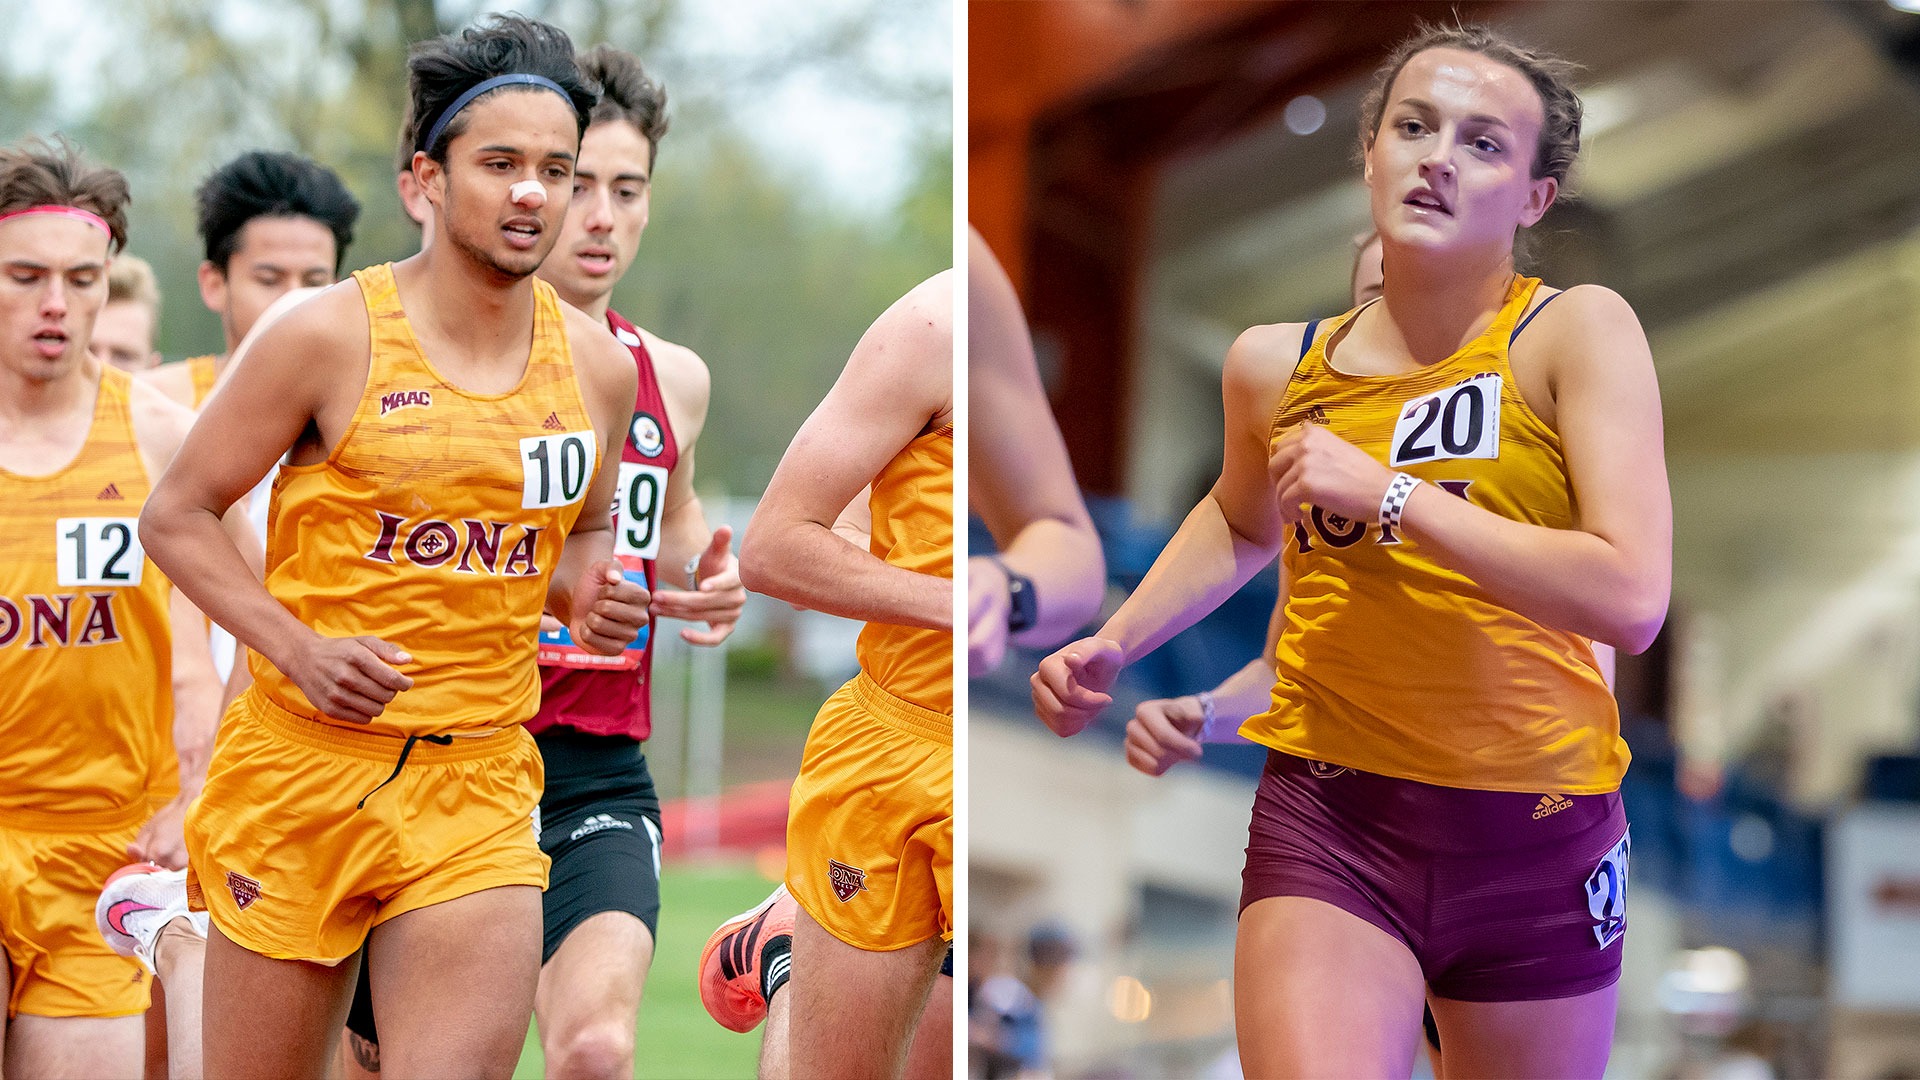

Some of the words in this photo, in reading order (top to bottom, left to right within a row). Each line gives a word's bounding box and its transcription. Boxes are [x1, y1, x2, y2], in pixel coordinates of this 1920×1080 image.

[380, 390, 433, 418] MAAC
[1396, 385, 1485, 463] 20
[528, 437, 586, 504] 10
[627, 473, 658, 549] 9
[65, 523, 131, 580] 12
[364, 510, 547, 577] IONA
[1532, 798, 1574, 820] adidas
[826, 859, 868, 891] IONA
